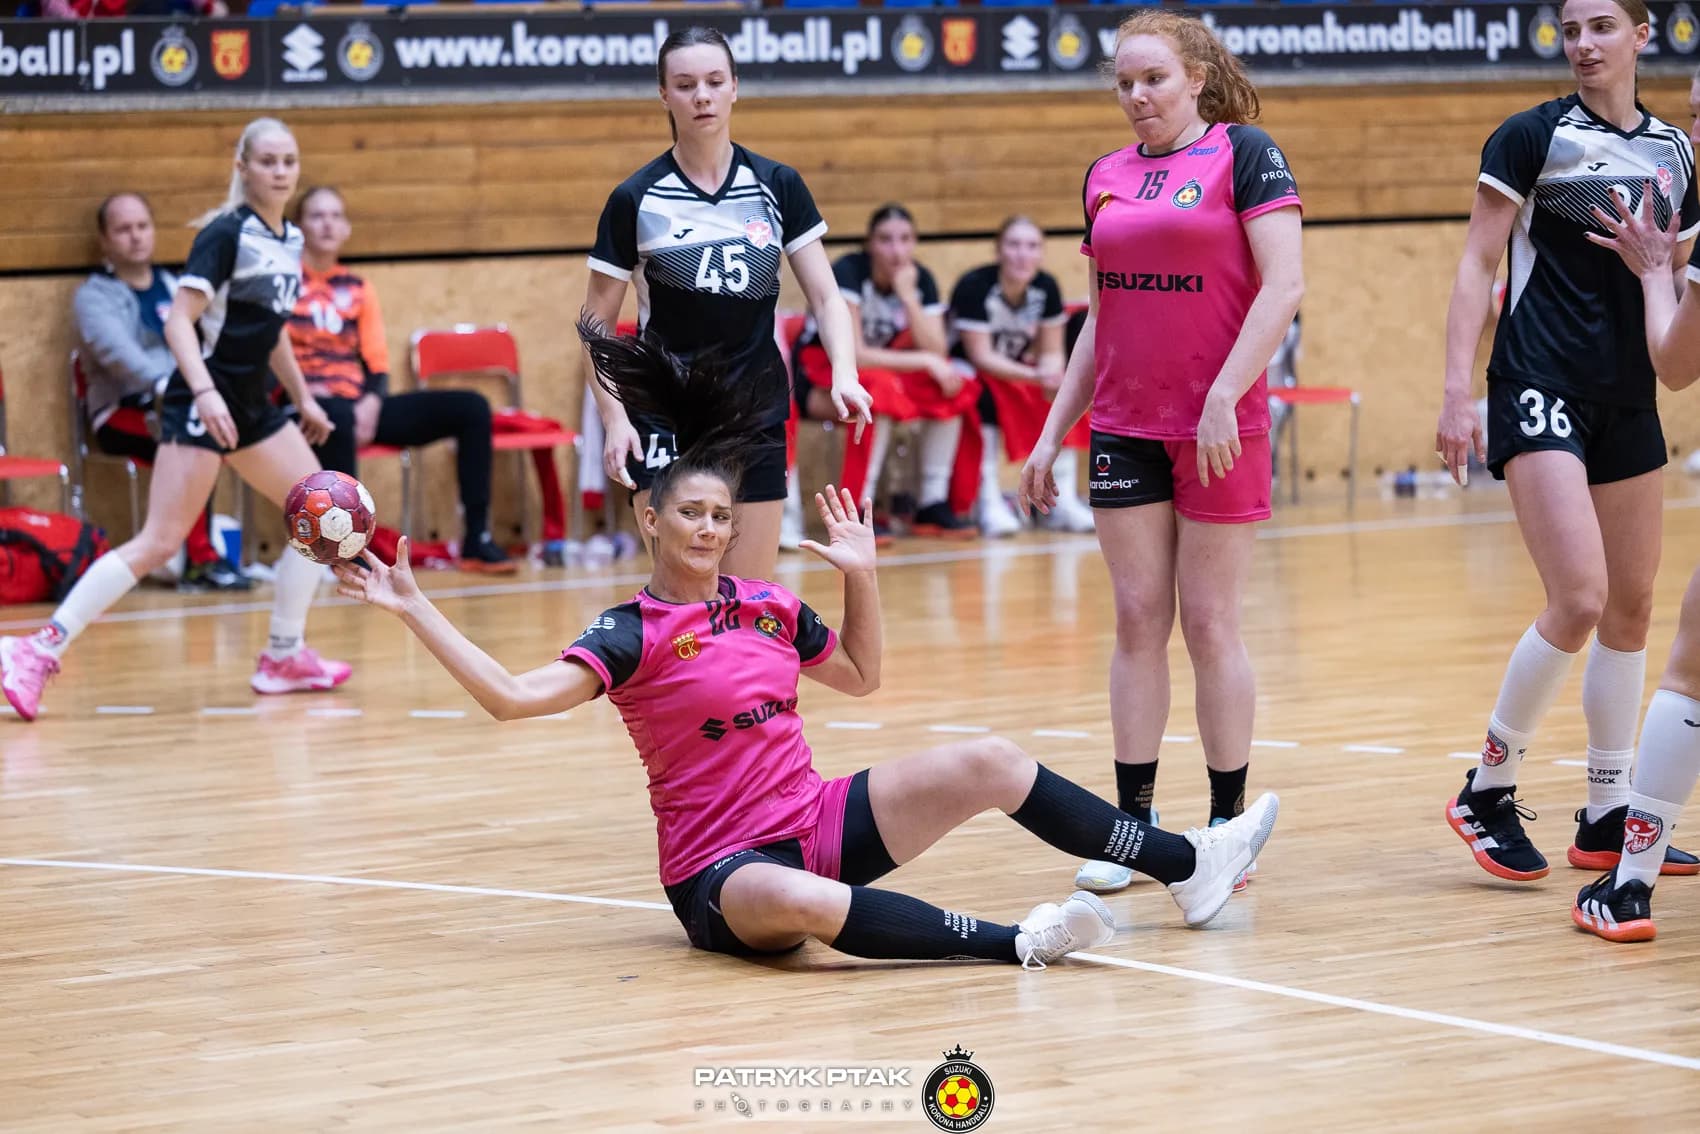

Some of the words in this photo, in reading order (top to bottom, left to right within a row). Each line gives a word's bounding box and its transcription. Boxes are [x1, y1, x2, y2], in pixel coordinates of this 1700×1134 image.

[395, 17, 881, 74] www.koronadball.pl
[1135, 169, 1170, 200] 15
[695, 245, 749, 293] 45
[1104, 271, 1203, 293] SUZUKI
[1519, 388, 1572, 438] 36
[646, 433, 680, 470] 4
[1089, 479, 1132, 489] arabela
[704, 599, 741, 636] 22
[678, 641, 699, 659] CK
[1104, 819, 1122, 853] SUZUKI
[1111, 820, 1130, 857] KORONA
[1129, 830, 1145, 860] KIELCE
